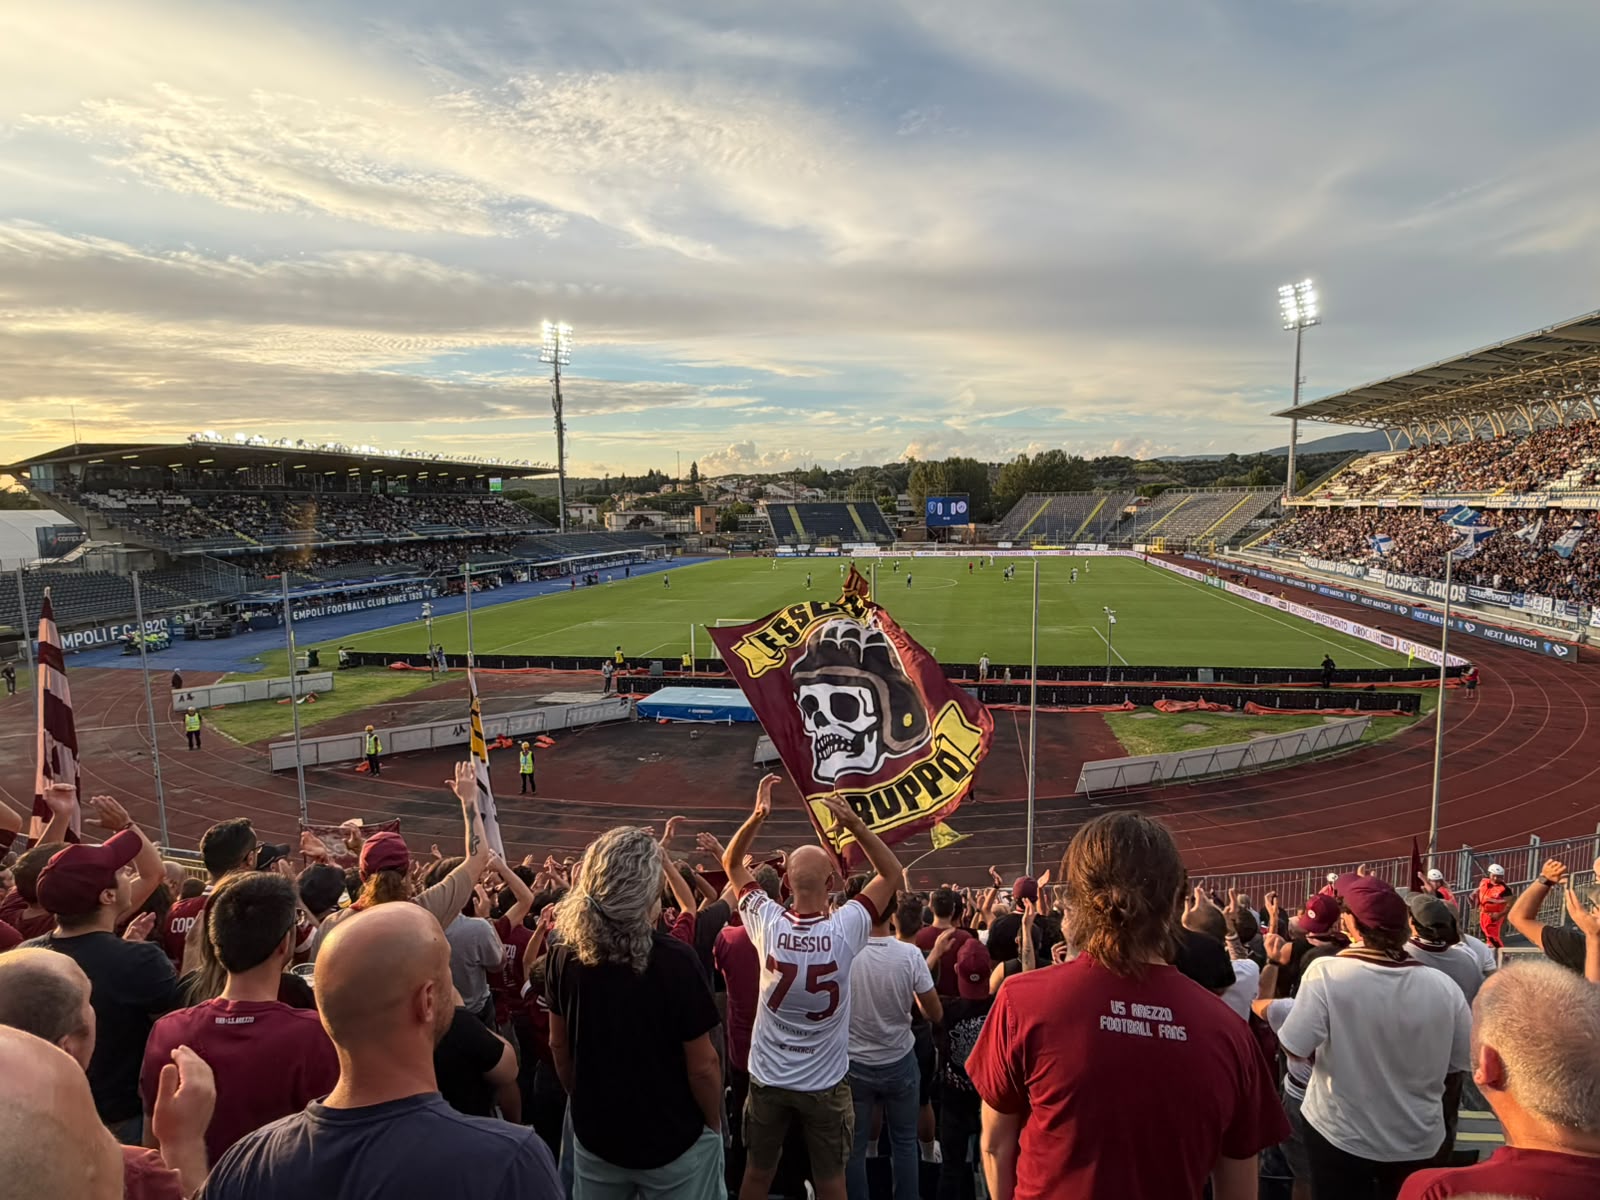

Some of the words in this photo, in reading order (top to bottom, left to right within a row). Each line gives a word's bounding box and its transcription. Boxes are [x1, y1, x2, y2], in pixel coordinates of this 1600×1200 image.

[1329, 589, 1344, 598] MATCH
[1361, 597, 1373, 605] NEXT
[1373, 600, 1391, 610] MATCH
[293, 607, 325, 620] EMPOLI
[327, 600, 365, 615] FOOTBALL
[367, 597, 386, 608] CLUB
[387, 593, 407, 604] SINCE
[409, 591, 423, 600] 1920
[1316, 612, 1347, 631] INVESTIMENTO
[1414, 610, 1429, 620] NEXT
[1430, 615, 1453, 627] MATH
[60, 628, 107, 650] MPOLI
[1353, 624, 1380, 642] OROCASH
[1484, 628, 1503, 640] NEXT
[1504, 634, 1537, 649] MATCH
[1417, 645, 1438, 663] FISICO
[845, 749, 969, 825] RUPPO
[777, 933, 832, 953] ALESSIO
[765, 954, 840, 1021] 75
[1110, 999, 1126, 1015] US
[1131, 1003, 1173, 1022] AREZZO
[1100, 1015, 1153, 1037] FOOTBALL
[1158, 1024, 1187, 1041] FANS
